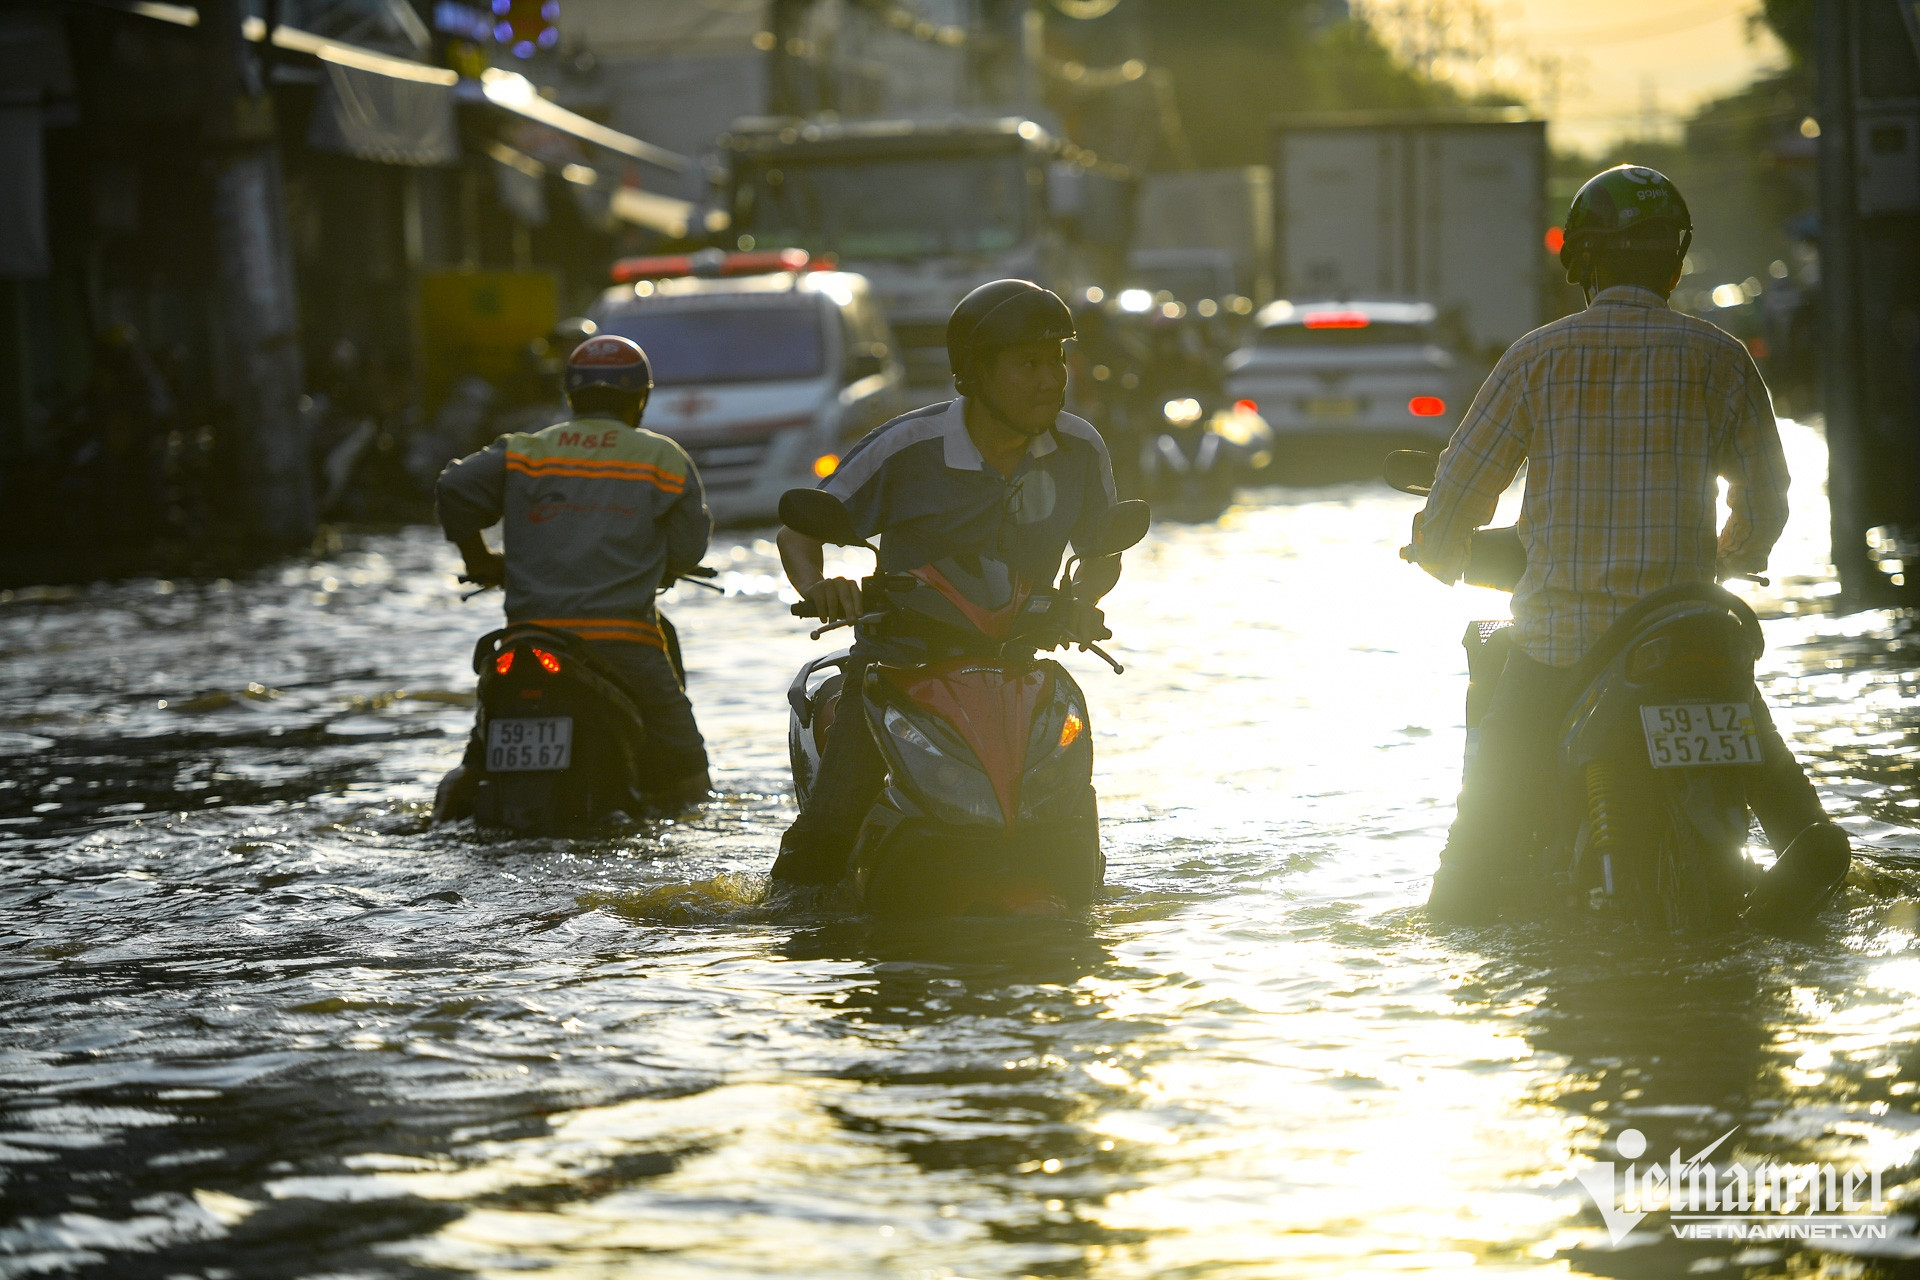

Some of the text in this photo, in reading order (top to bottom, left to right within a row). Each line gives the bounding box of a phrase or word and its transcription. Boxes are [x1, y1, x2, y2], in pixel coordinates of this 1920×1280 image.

[1636, 187, 1669, 200] gojek
[558, 430, 619, 448] M&E
[492, 744, 565, 768] 065.67
[1654, 734, 1753, 763] 552.51
